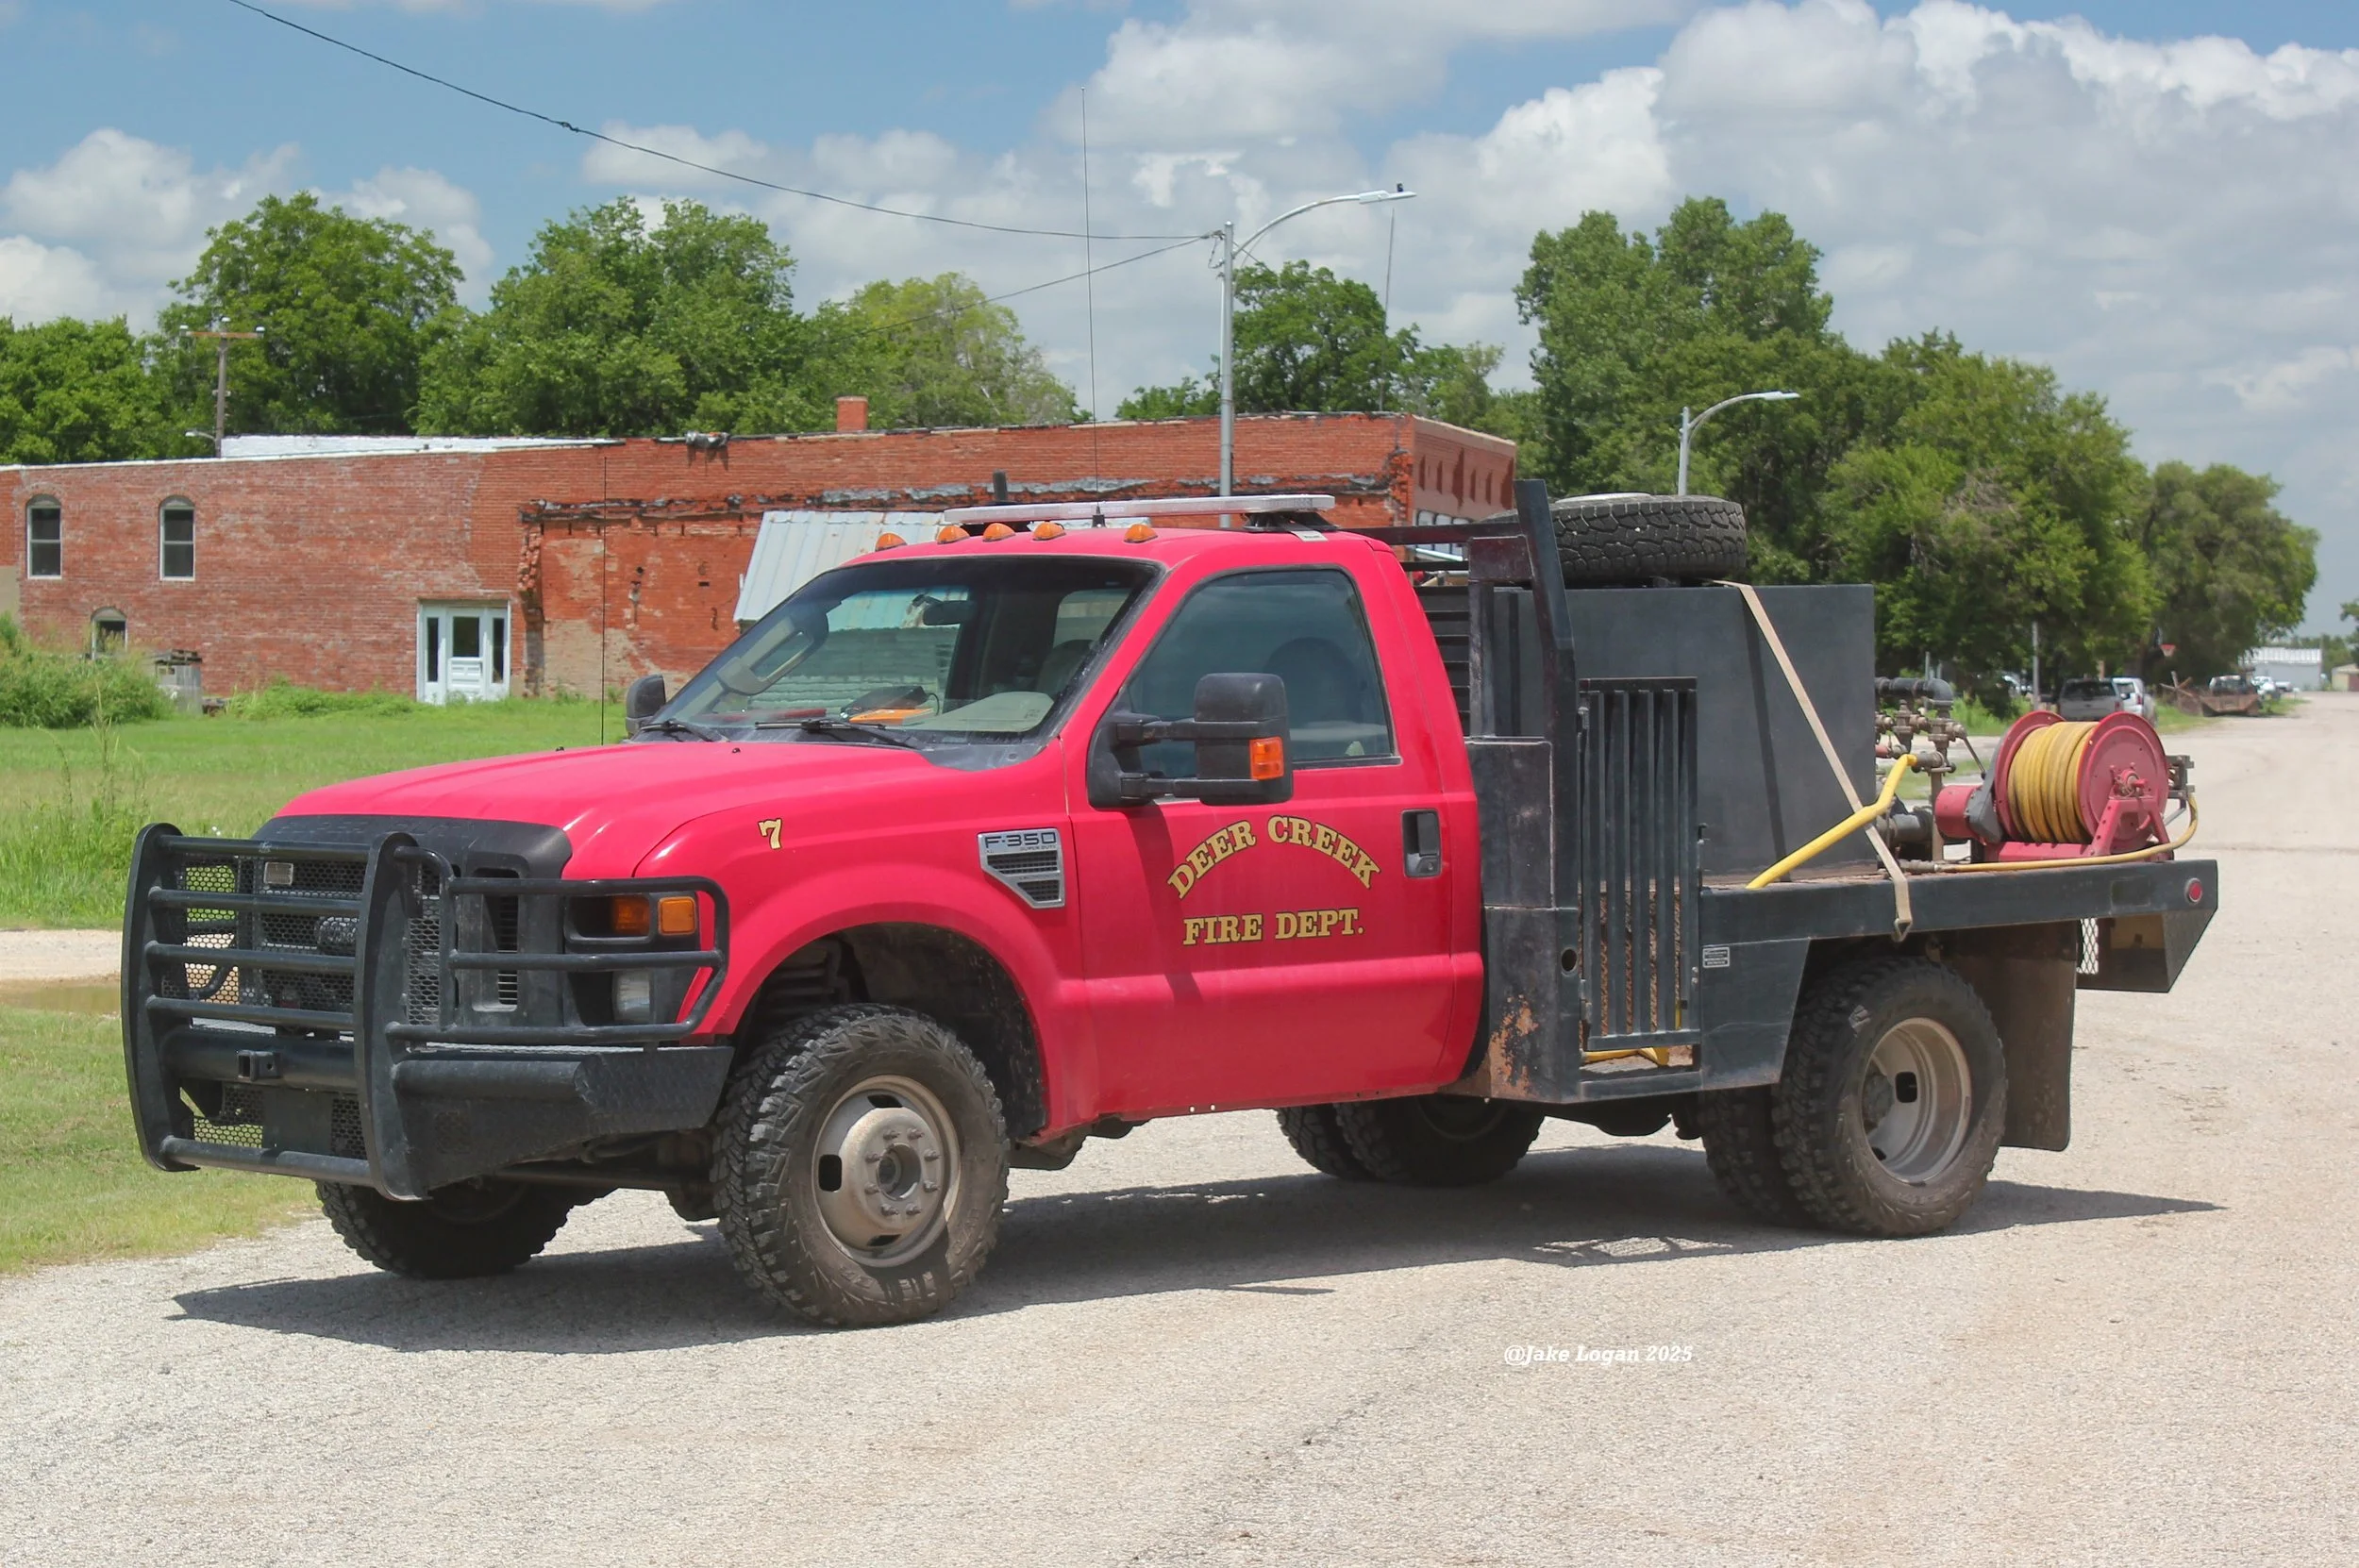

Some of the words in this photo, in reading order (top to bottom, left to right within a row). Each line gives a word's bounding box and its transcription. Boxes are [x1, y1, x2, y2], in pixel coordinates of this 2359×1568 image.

[758, 818, 782, 850] 7
[984, 832, 1057, 848] F-350
[1166, 820, 1257, 899] DEER
[1267, 815, 1381, 889] CREEK
[1183, 913, 1263, 945] FIRE
[1275, 909, 1364, 939] DEPT.
